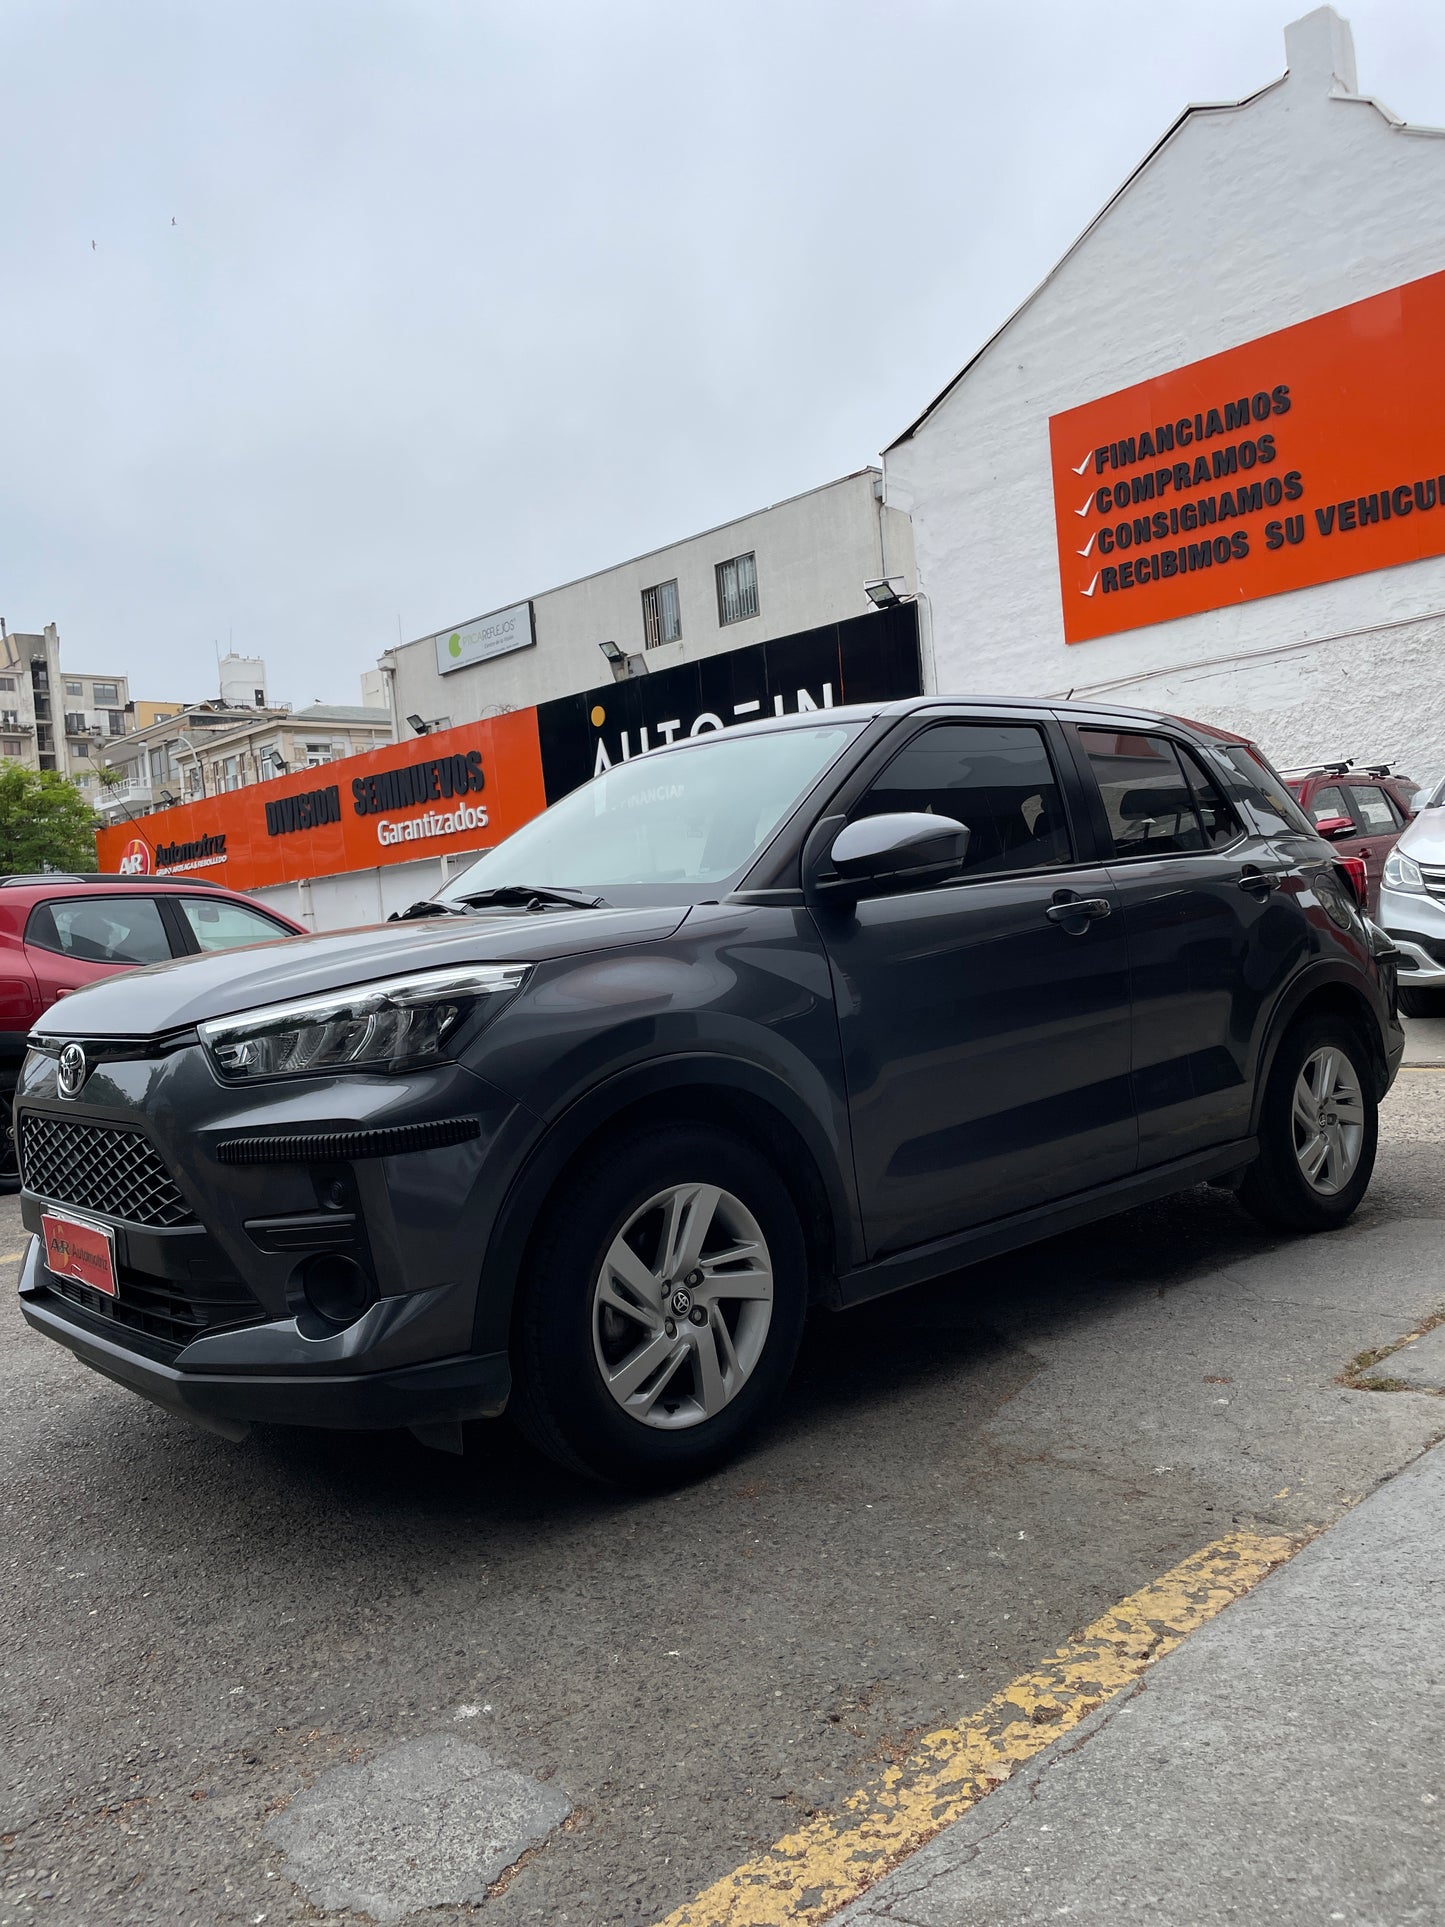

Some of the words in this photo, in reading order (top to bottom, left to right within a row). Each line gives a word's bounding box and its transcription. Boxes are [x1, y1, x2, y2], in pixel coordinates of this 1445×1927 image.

[1094, 384, 1291, 475] FINANCIAMOS
[1095, 434, 1277, 514] COMPRAMOS
[1098, 470, 1304, 554] CONSIGNAMOS
[1101, 531, 1250, 594] RECIBIMOS
[1265, 514, 1305, 551] SU
[265, 785, 341, 836] DIVISION
[352, 750, 485, 816] SEMINUEVOS
[377, 802, 489, 846] Garantizados
[155, 833, 227, 867] Automotriz
